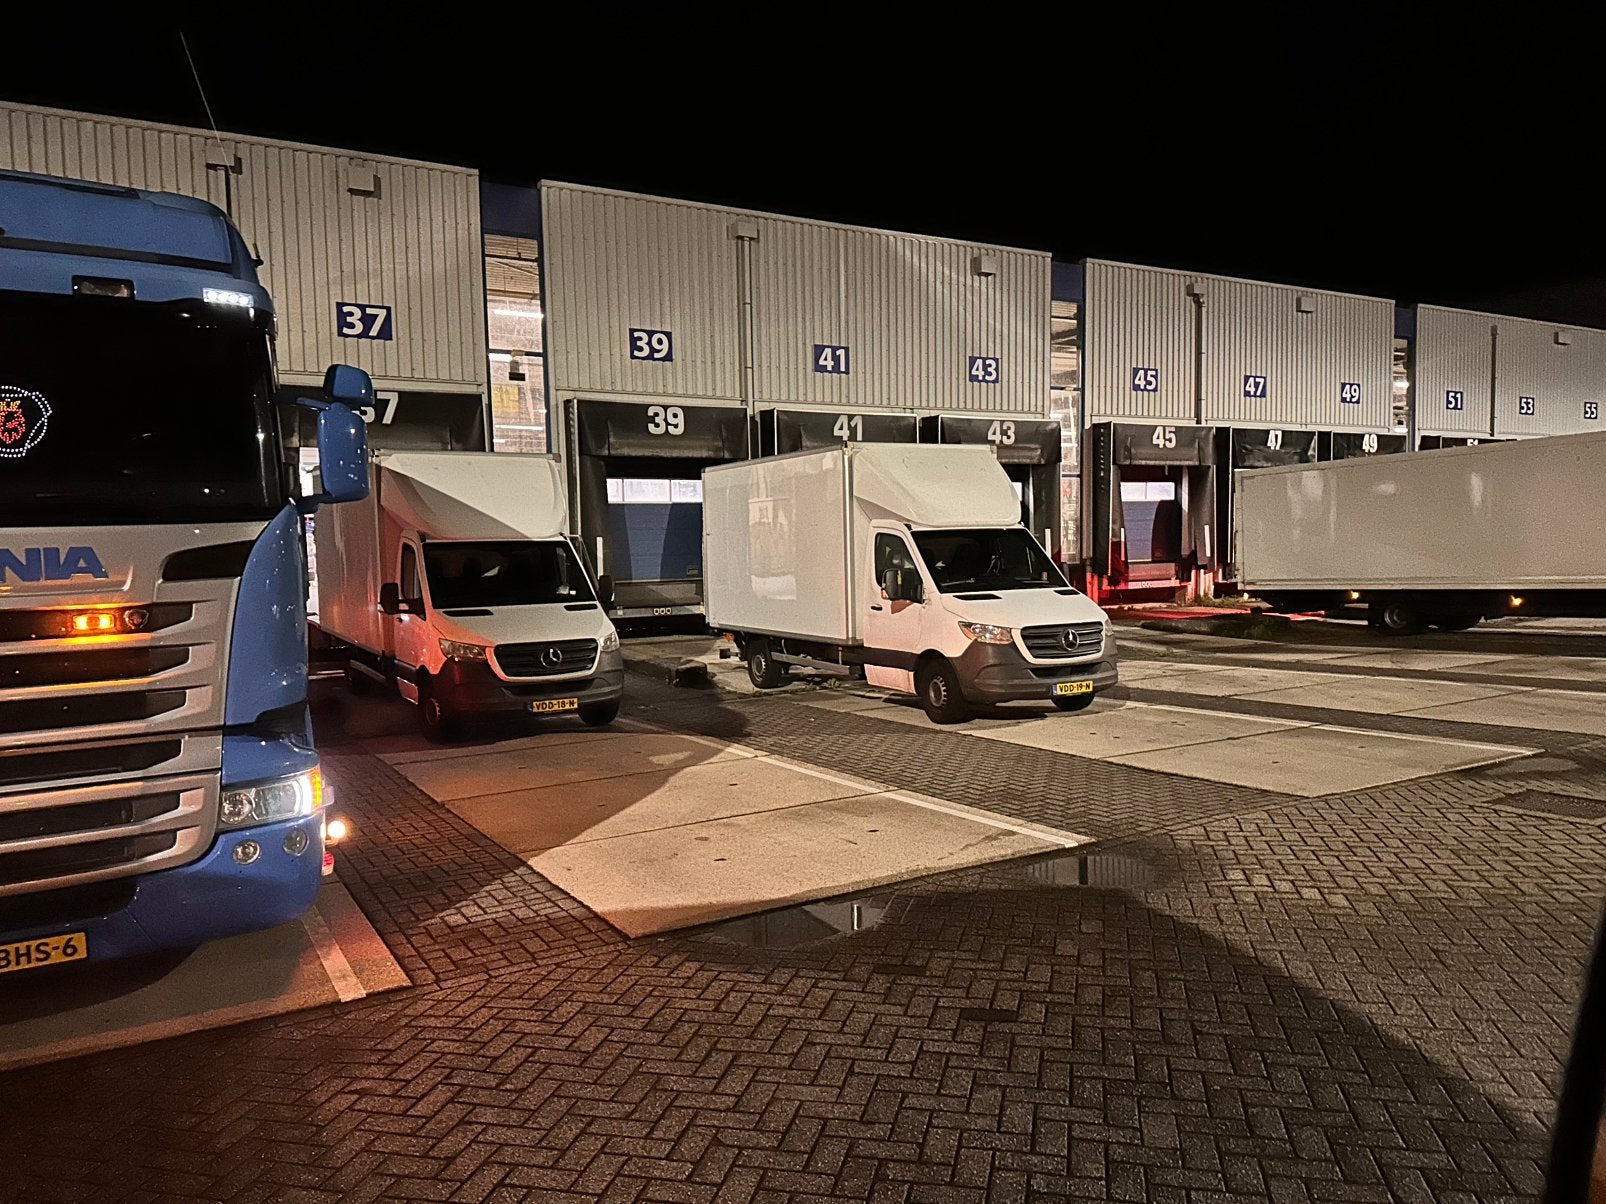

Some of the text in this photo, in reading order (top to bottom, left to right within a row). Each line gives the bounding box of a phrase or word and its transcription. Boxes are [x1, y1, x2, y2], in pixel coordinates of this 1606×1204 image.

[342, 305, 387, 337] 37
[633, 331, 669, 358] 39
[818, 347, 846, 372] 41
[971, 358, 997, 381] 43
[1134, 369, 1157, 390] 45
[1245, 377, 1264, 396] 47
[1342, 384, 1359, 402] 49
[1448, 392, 1461, 409] 51
[1520, 398, 1533, 414] 53
[1585, 403, 1597, 418] 55
[647, 405, 685, 435] 39
[833, 414, 863, 441] 41
[987, 420, 1015, 445] 43
[1152, 426, 1176, 449] 45
[1267, 430, 1283, 450] 47
[1362, 433, 1378, 453] 49
[1058, 682, 1091, 693] VDD-19-N
[535, 699, 575, 711] VDD-18-N
